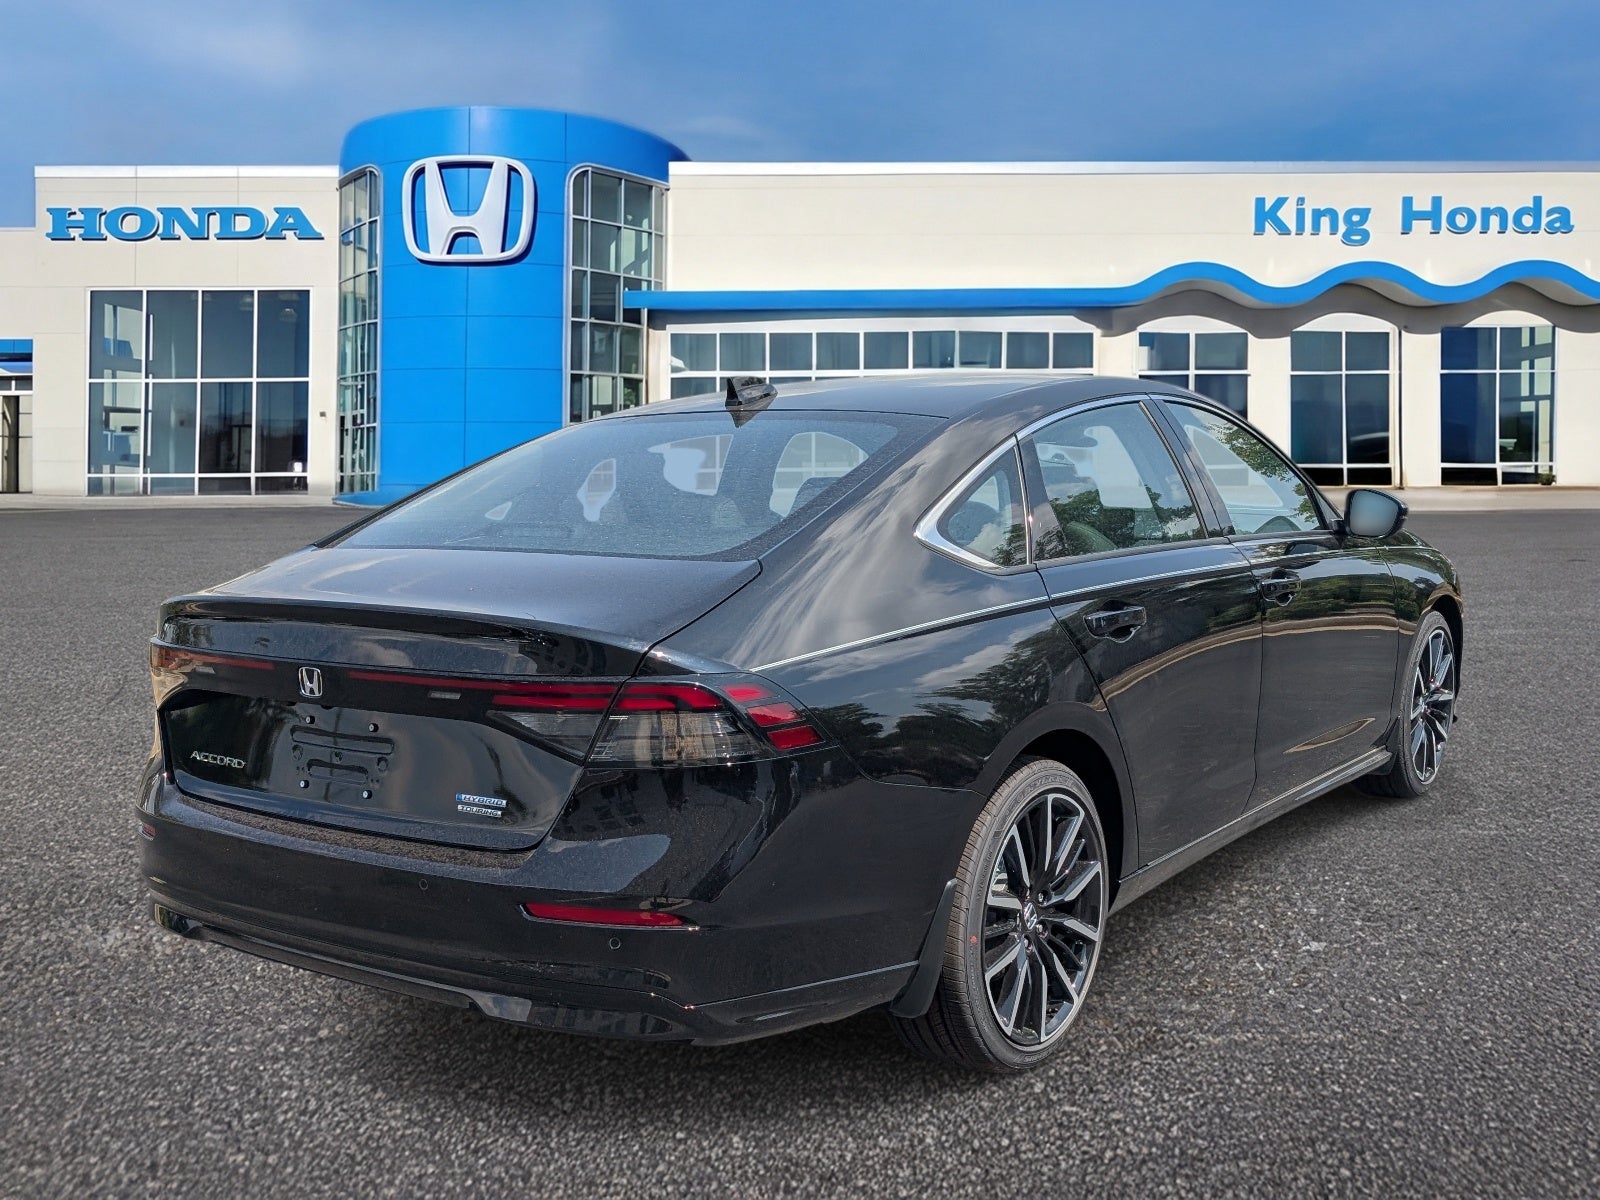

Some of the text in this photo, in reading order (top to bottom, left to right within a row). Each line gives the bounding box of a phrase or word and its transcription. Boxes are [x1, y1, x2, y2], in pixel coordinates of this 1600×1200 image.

[46, 206, 325, 241] HONDA
[1254, 195, 1575, 246] King Honda
[190, 751, 247, 769] ACCORD
[463, 795, 504, 806] HYBRID
[458, 805, 499, 816] TOURING
